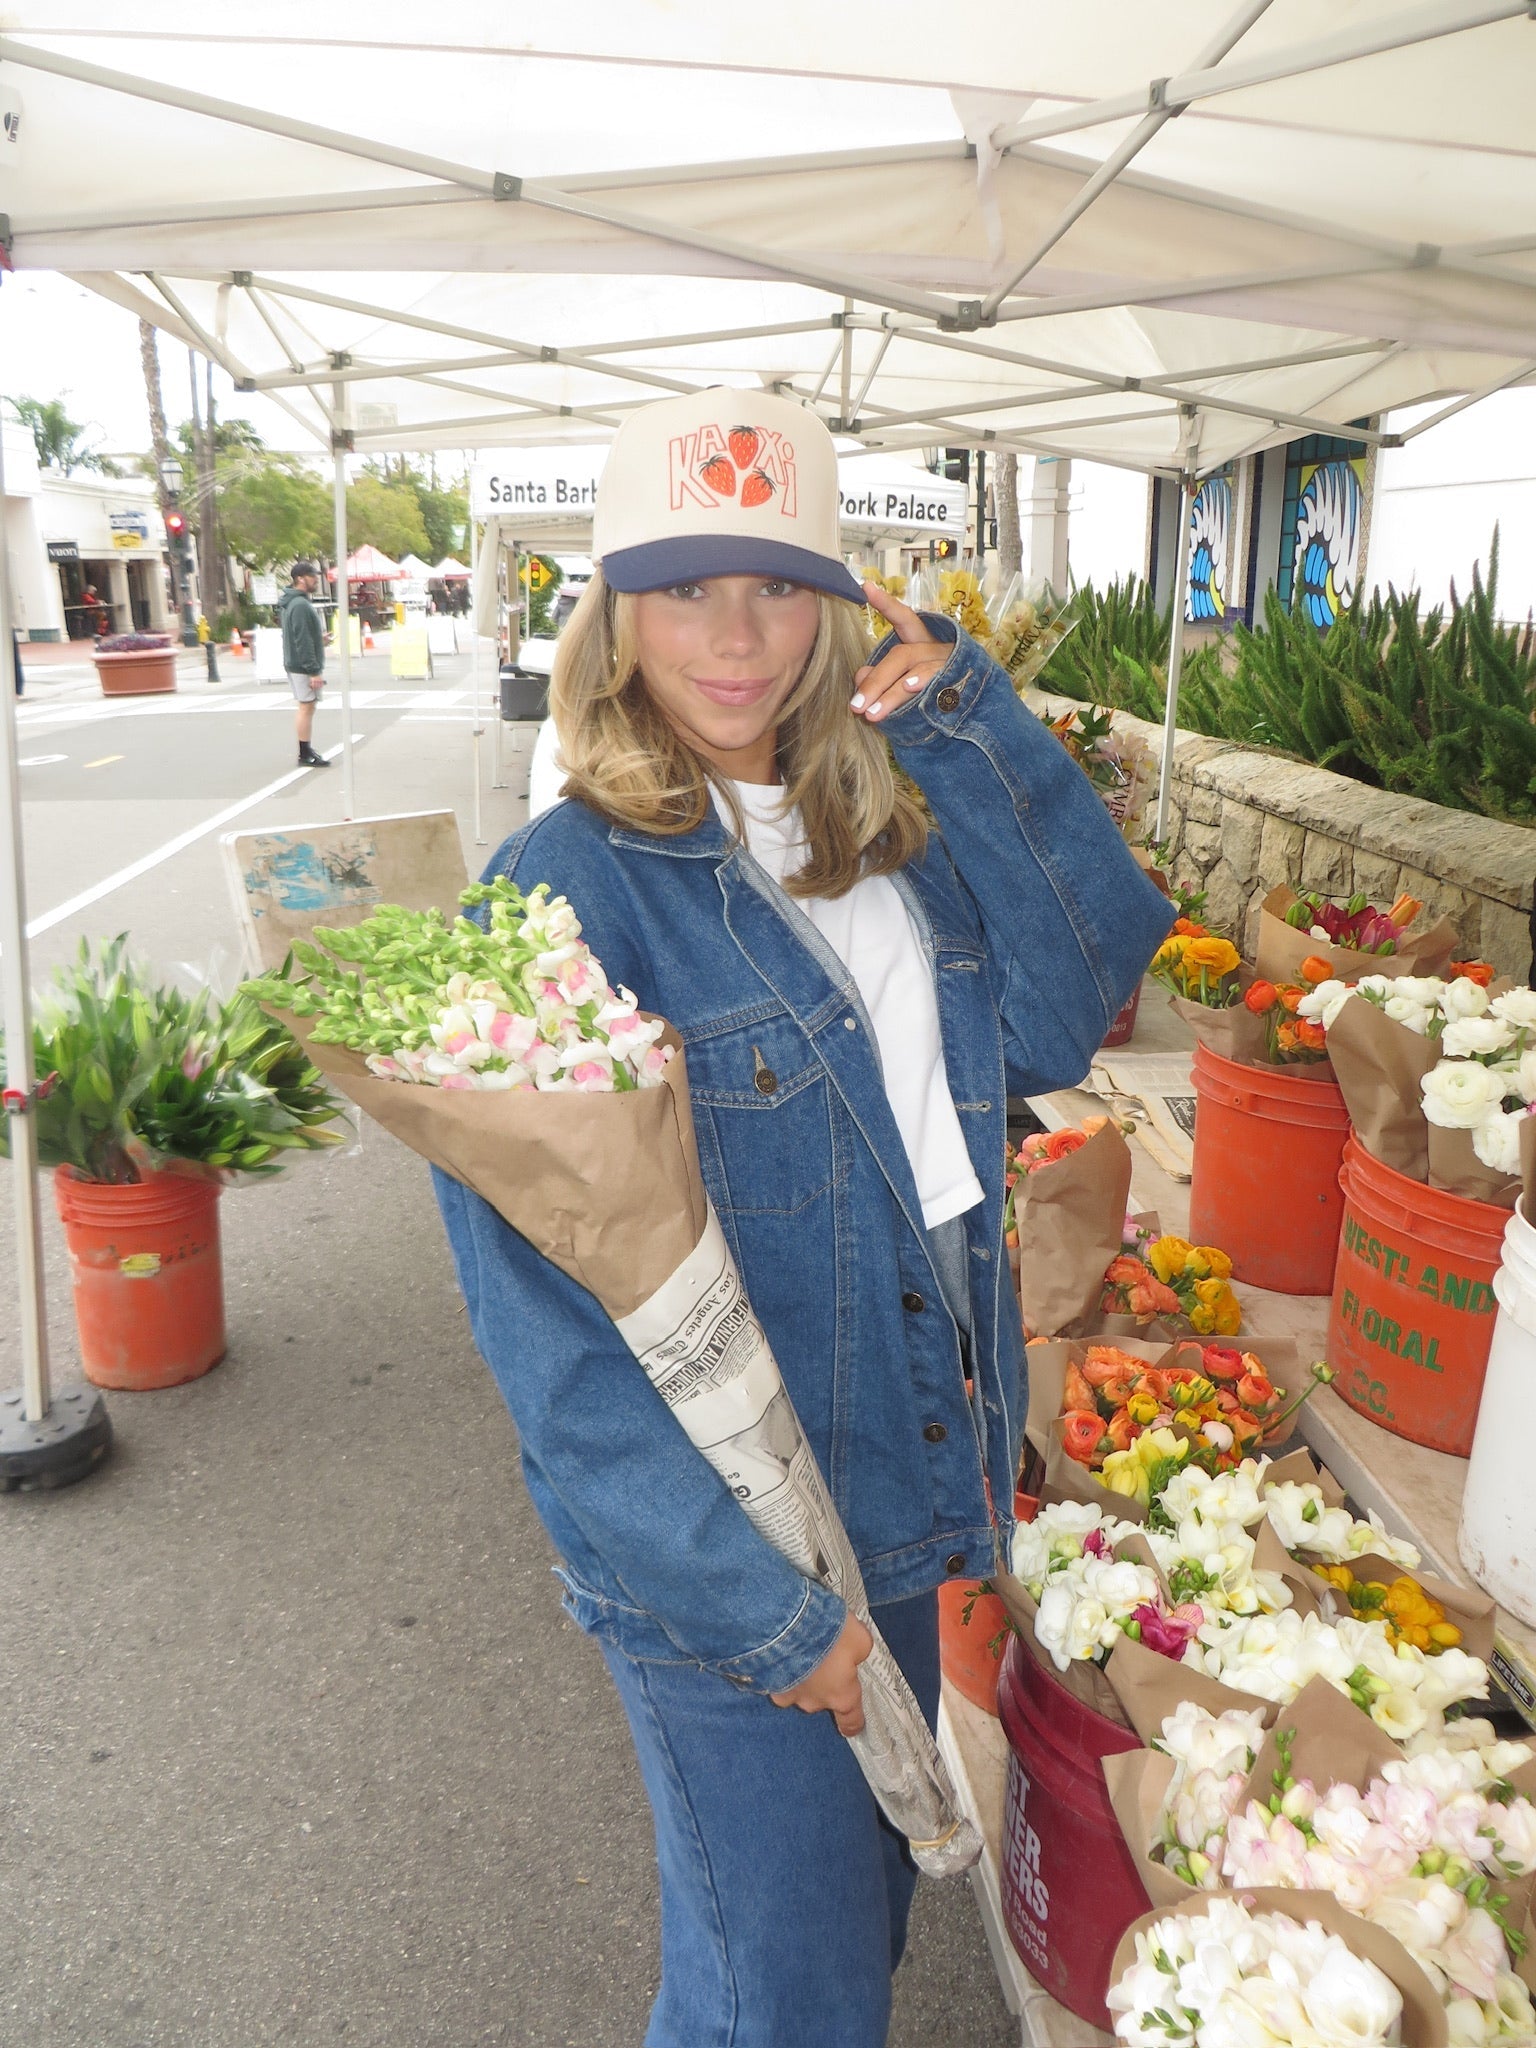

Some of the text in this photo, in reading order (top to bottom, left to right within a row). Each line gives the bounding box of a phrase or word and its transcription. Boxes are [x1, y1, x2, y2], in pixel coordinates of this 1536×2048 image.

[489, 476, 547, 503] Santa
[886, 494, 948, 521] Palace
[719, 1271, 735, 1295] Los
[1343, 1213, 1495, 1314] WESTLAND
[685, 1294, 721, 1338] Angeles
[709, 1292, 750, 1350] LIFORNIA
[1341, 1287, 1445, 1374] FLORAL
[656, 1340, 689, 1361] Times
[1491, 1651, 1531, 1704] LIFETIME
